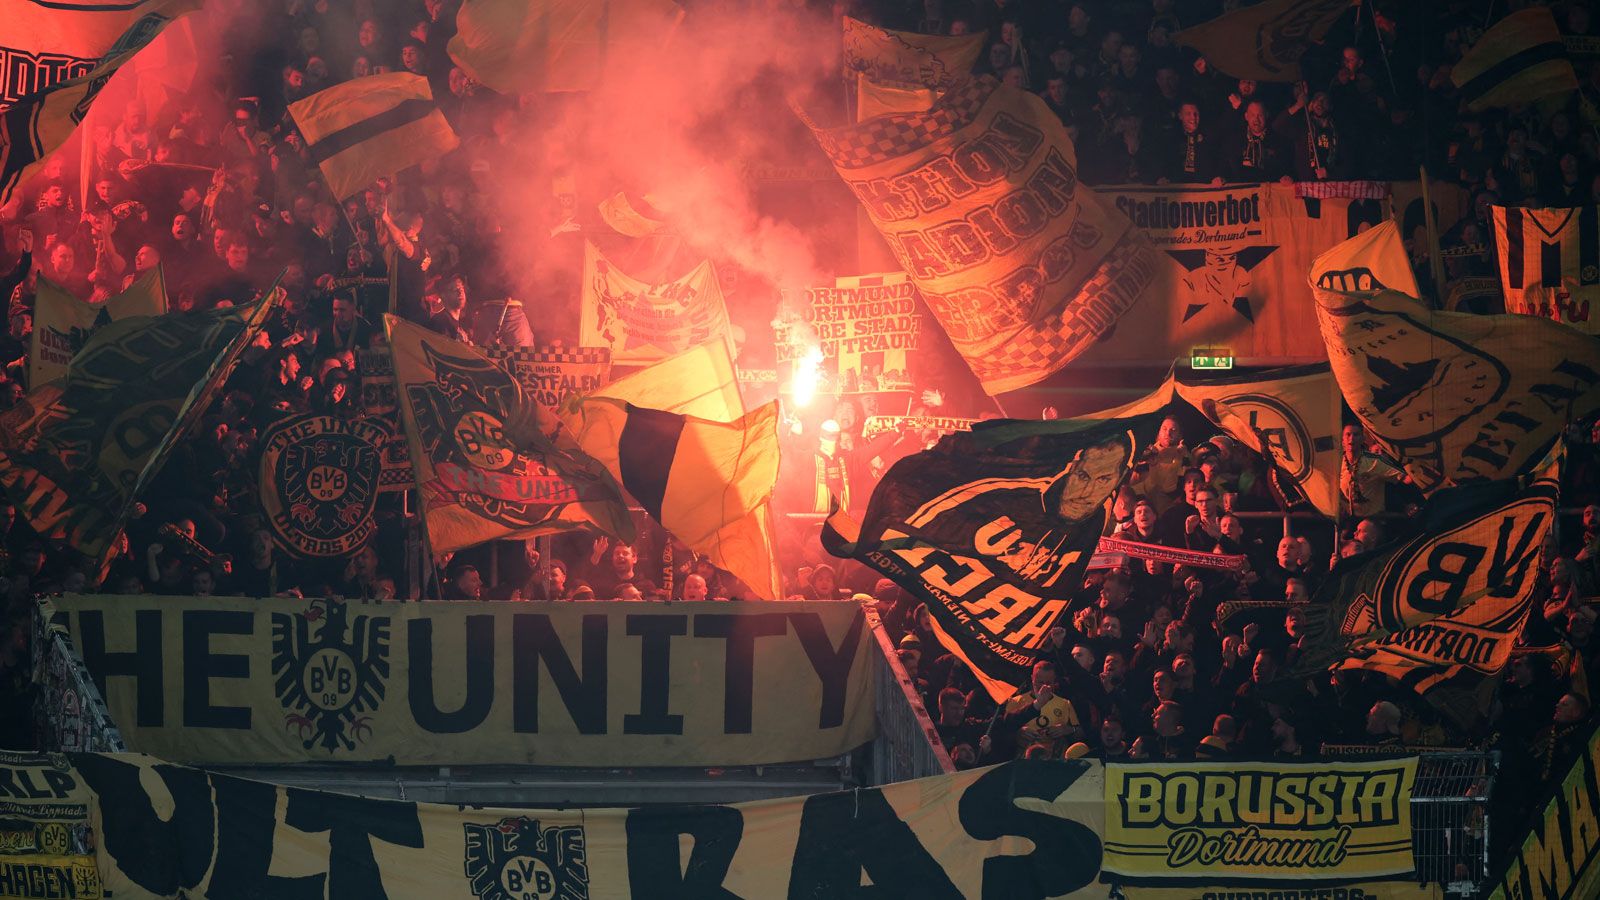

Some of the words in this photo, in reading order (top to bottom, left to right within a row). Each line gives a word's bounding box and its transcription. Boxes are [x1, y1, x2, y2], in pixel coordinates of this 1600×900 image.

[1116, 193, 1261, 229] Stadionverbot
[1195, 228, 1248, 244] Dortmund
[842, 334, 921, 354] TRAUM
[535, 366, 562, 375] IMMER
[517, 373, 602, 392] ESTFALEN
[267, 420, 316, 453] THE
[485, 452, 505, 465] 09
[310, 467, 345, 490] BVB
[445, 466, 504, 496] THE
[515, 478, 592, 500] UNITY
[319, 489, 333, 498] 09
[50, 610, 255, 730] HE
[407, 612, 866, 736] UNITY
[311, 655, 352, 694] BVB
[322, 693, 338, 706] 09
[1124, 769, 1401, 828] BORUSSIA
[45, 826, 67, 848] BVB
[1167, 825, 1352, 868] Dortmund
[506, 859, 552, 894] BVB
